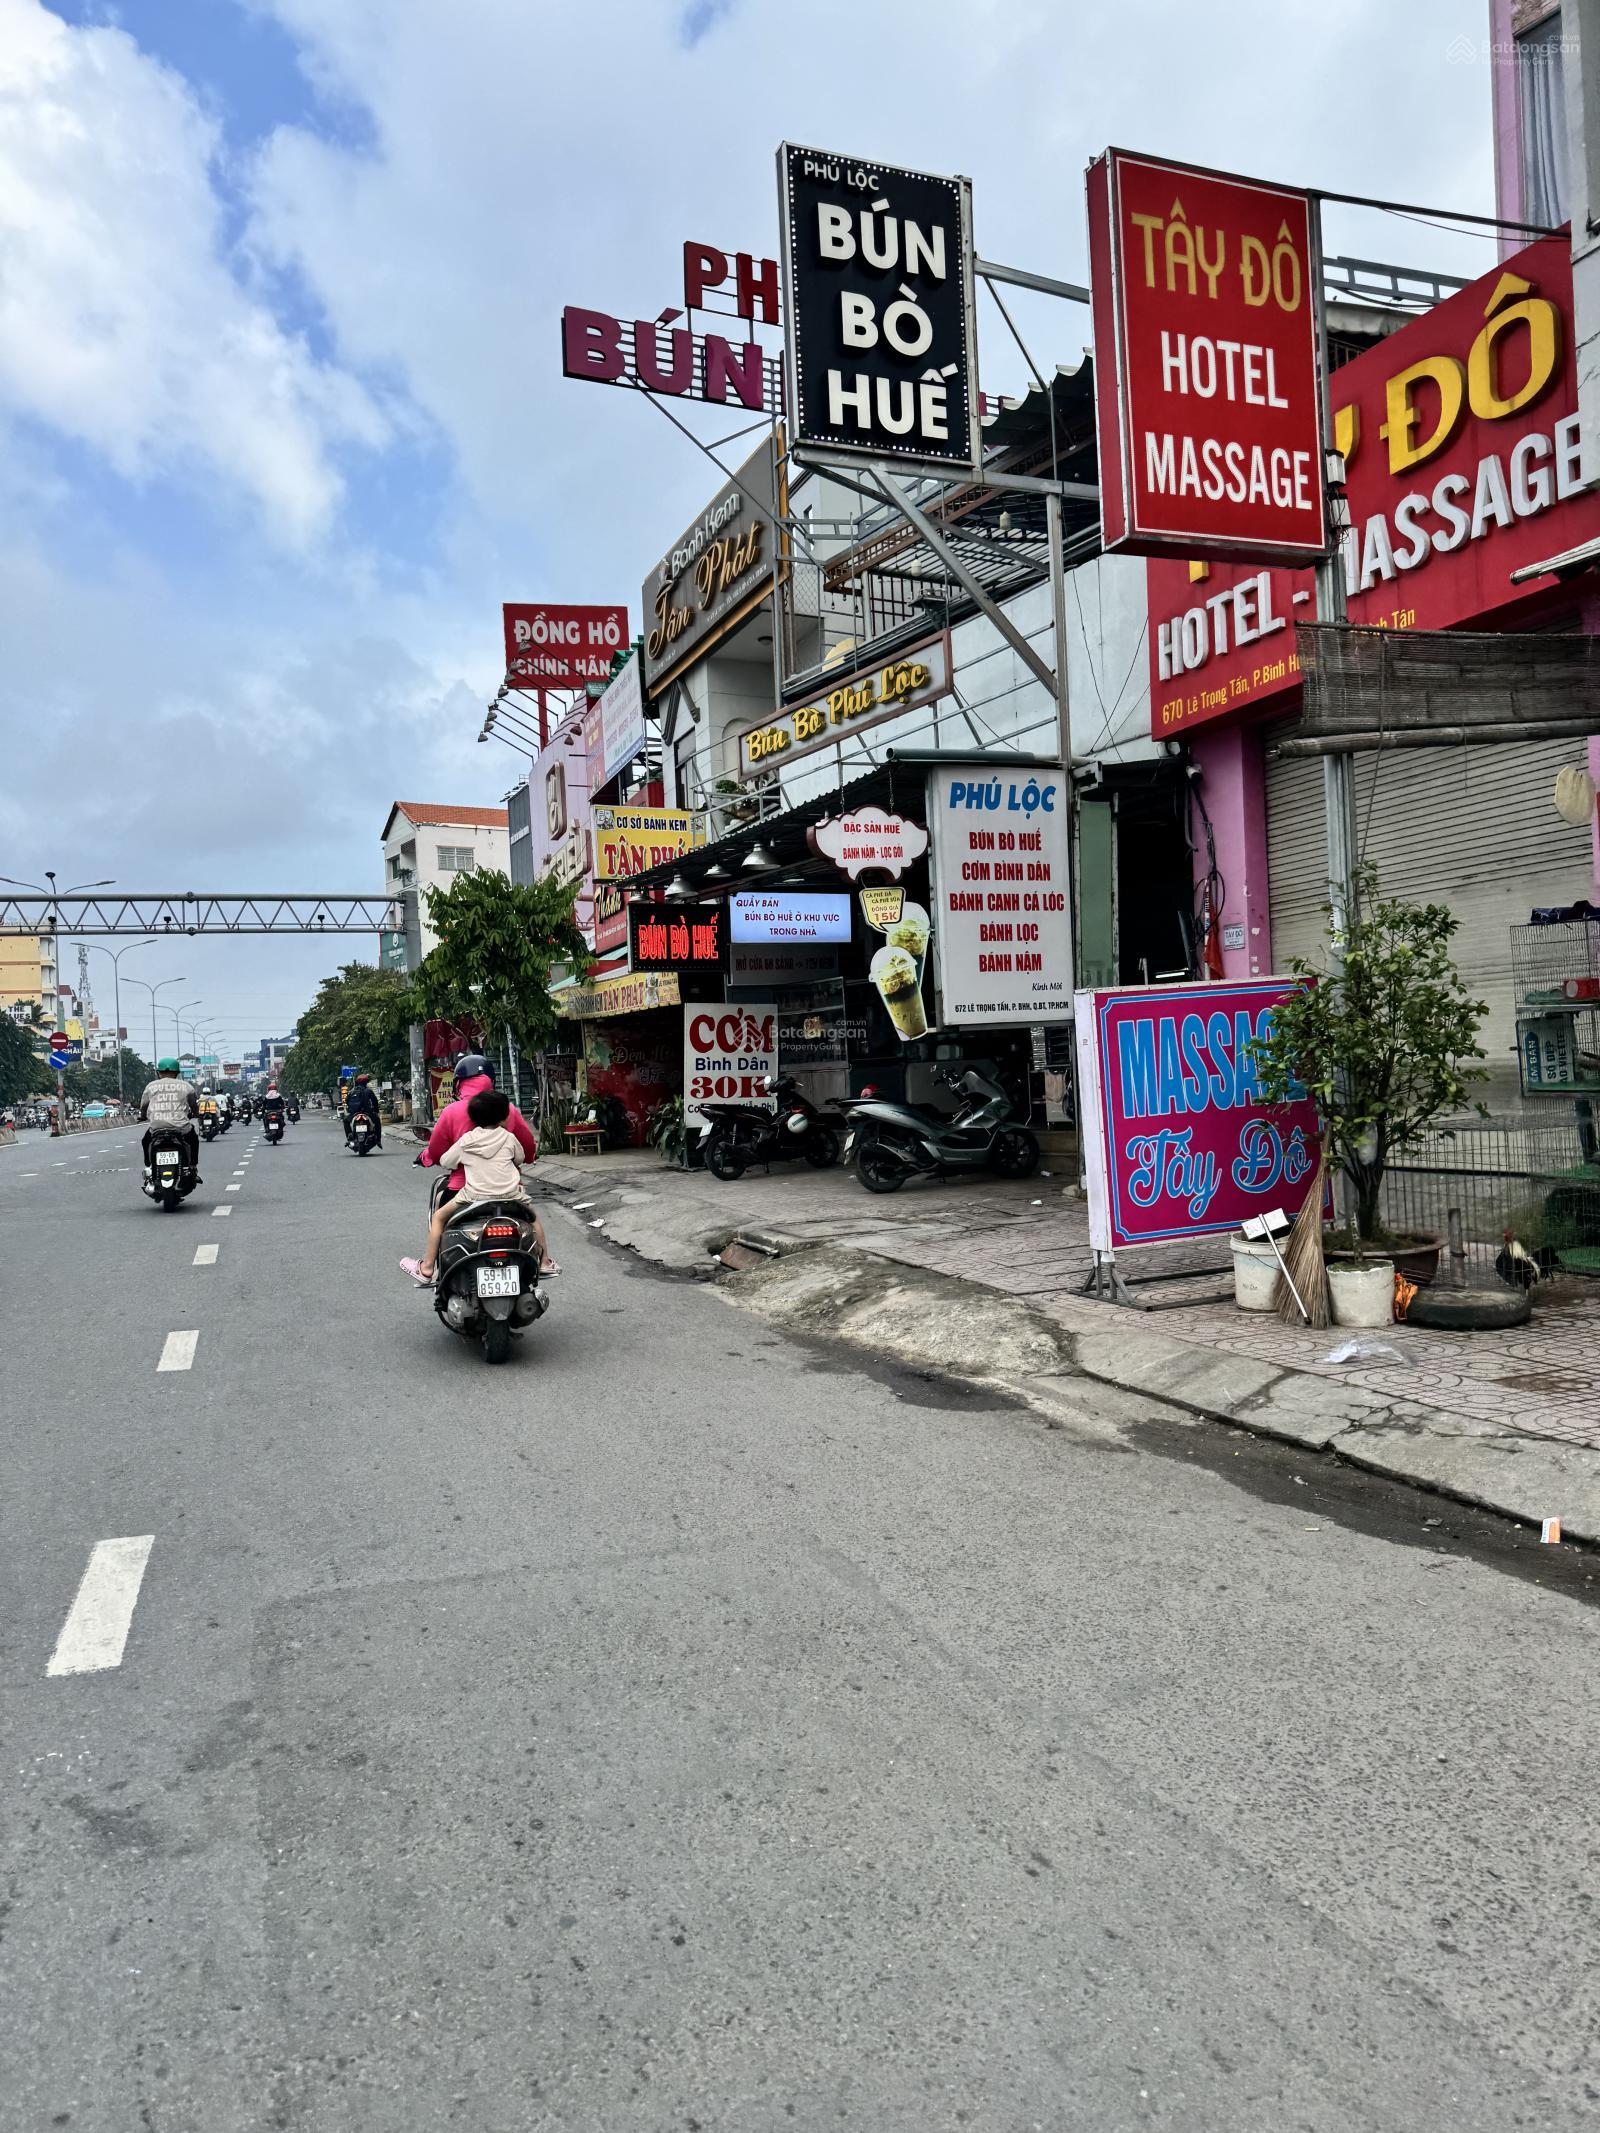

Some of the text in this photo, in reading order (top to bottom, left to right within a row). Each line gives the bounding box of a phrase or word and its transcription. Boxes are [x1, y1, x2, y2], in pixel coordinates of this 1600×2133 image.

[804, 158, 880, 192] PHÚ LỘC
[817, 198, 947, 279] BÚN
[1131, 195, 1301, 313] TÂY ĐÔ
[683, 240, 780, 327] PH
[840, 282, 933, 358] BÒ
[562, 305, 764, 412] BÚN
[1160, 330, 1289, 409] HOTEL
[1378, 271, 1561, 476] ĐÔ
[827, 363, 959, 440] HUẾ
[1144, 431, 1313, 511] MASSAGE
[694, 519, 763, 611] Phát
[513, 611, 621, 646] ĐỒNG HỒ
[1156, 571, 1286, 681] HOTEL
[517, 653, 617, 677] CHÍNH HÃN
[1162, 698, 1184, 726] 670
[1187, 693, 1199, 715] Lê
[1201, 687, 1227, 710] Trọng
[1229, 674, 1250, 695] Tấn,
[1253, 659, 1285, 688] P.Bình
[1392, 608, 1416, 629] Tân
[746, 660, 929, 763] Bún Bò Phú Lộc
[950, 775, 1057, 820] PHÚ LỘC
[644, 815, 667, 831] BÁNH
[669, 819, 687, 831] KEM
[843, 820, 901, 837] ĐẶC SẢN HUẾ
[969, 827, 1042, 851] BÚN BÒ HUẾ
[604, 835, 645, 876] TÂN
[843, 846, 860, 859] BÁNH
[861, 844, 875, 861] NẬM
[880, 846, 892, 862] LỌC
[962, 859, 1051, 881] CƠM BÌNH DÂN
[745, 910, 761, 921] BÚN
[764, 910, 775, 921] BÒ
[777, 909, 793, 921] HUẾ
[804, 913, 820, 922] KHU
[823, 913, 840, 924] VỰC
[761, 896, 779, 907] BÁN
[874, 911, 897, 922] 15K
[950, 890, 1065, 911] BÁNH CANH CÁ LÓC
[639, 915, 667, 960] BÚN
[670, 915, 690, 960] BÒ
[692, 911, 719, 960] HUẾ
[769, 926, 817, 936] TRONG NHÀ
[980, 920, 1039, 945] BÁNH LỌC
[979, 951, 1042, 975] BÁNH NẬM
[955, 1004, 966, 1013] 672
[967, 1002, 975, 1013] LÊ
[976, 1003, 996, 1014] TRỌNG
[689, 1007, 775, 1054] CƠM
[695, 1056, 769, 1071] Bình Dân
[690, 1076, 772, 1099] 30K
[1125, 1117, 1312, 1220] Tây Đô
[480, 1281, 518, 1295] 859.20
